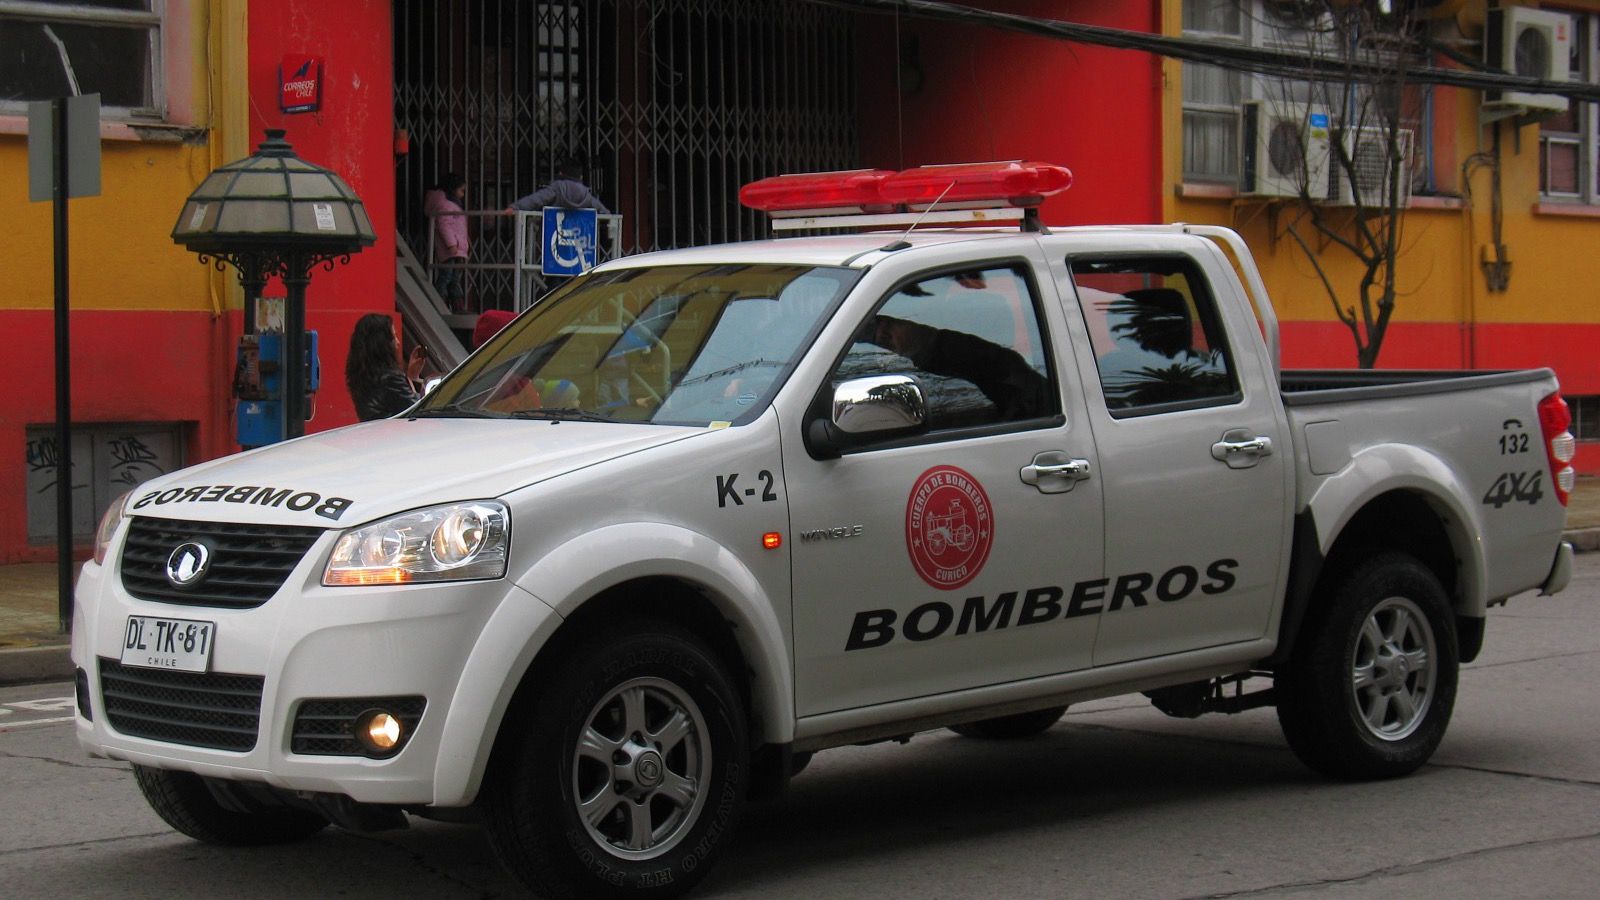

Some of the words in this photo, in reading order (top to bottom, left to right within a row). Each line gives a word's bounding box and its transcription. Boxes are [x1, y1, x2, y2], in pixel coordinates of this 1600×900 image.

[284, 80, 315, 92] CORREOS
[296, 90, 312, 98] CHILE
[1499, 433, 1529, 455] 132
[716, 469, 777, 508] K-2
[912, 483, 933, 529] CUERPO
[931, 474, 944, 486] DE
[945, 473, 988, 521] BOMBEROS
[800, 524, 864, 545] WINGLE
[936, 565, 968, 581] CURICO
[844, 558, 1240, 651] BOMBEROS
[147, 657, 177, 667] CHILE
